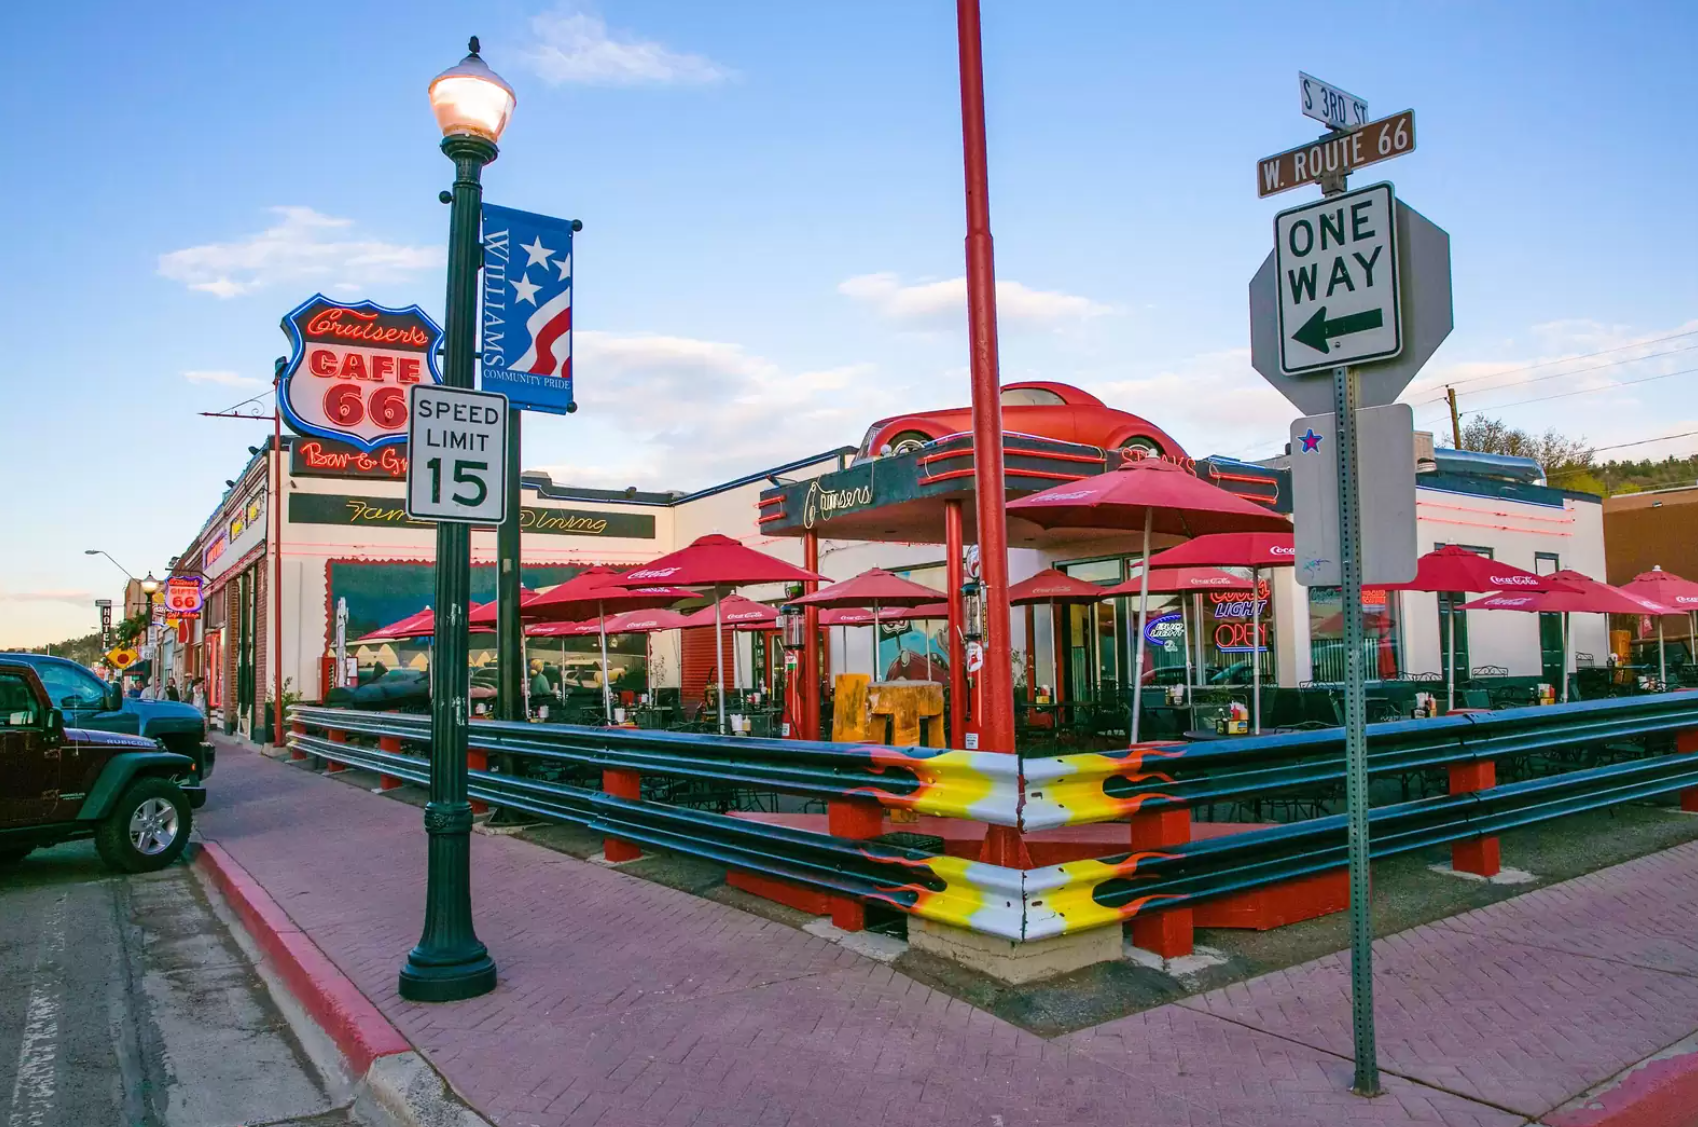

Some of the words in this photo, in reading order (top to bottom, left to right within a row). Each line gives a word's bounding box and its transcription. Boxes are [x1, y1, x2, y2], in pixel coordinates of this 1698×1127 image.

[1303, 79, 1313, 111] S
[1321, 87, 1346, 123] 3RD
[1353, 101, 1367, 125] ST
[1263, 159, 1285, 190] W.
[1294, 131, 1365, 182] ROUTE
[1378, 117, 1408, 155] 66
[1288, 200, 1376, 258] ONE
[1287, 245, 1384, 305] WAY
[483, 228, 510, 367] WILLIAMS
[308, 349, 421, 384] CAFE
[484, 369, 542, 386] COMMUNITY
[543, 378, 571, 390] PRIDE
[323, 383, 409, 430] 66
[418, 399, 499, 425] SPEED
[300, 442, 350, 468] Bar
[427, 428, 490, 452] LIMIT
[427, 457, 489, 507] 15
[172, 596, 195, 608] 66
[1214, 600, 1268, 618] LIGHT
[103, 607, 111, 649] HOTEL
[1215, 622, 1266, 647] OPEN
[106, 738, 151, 747] RUBICON
